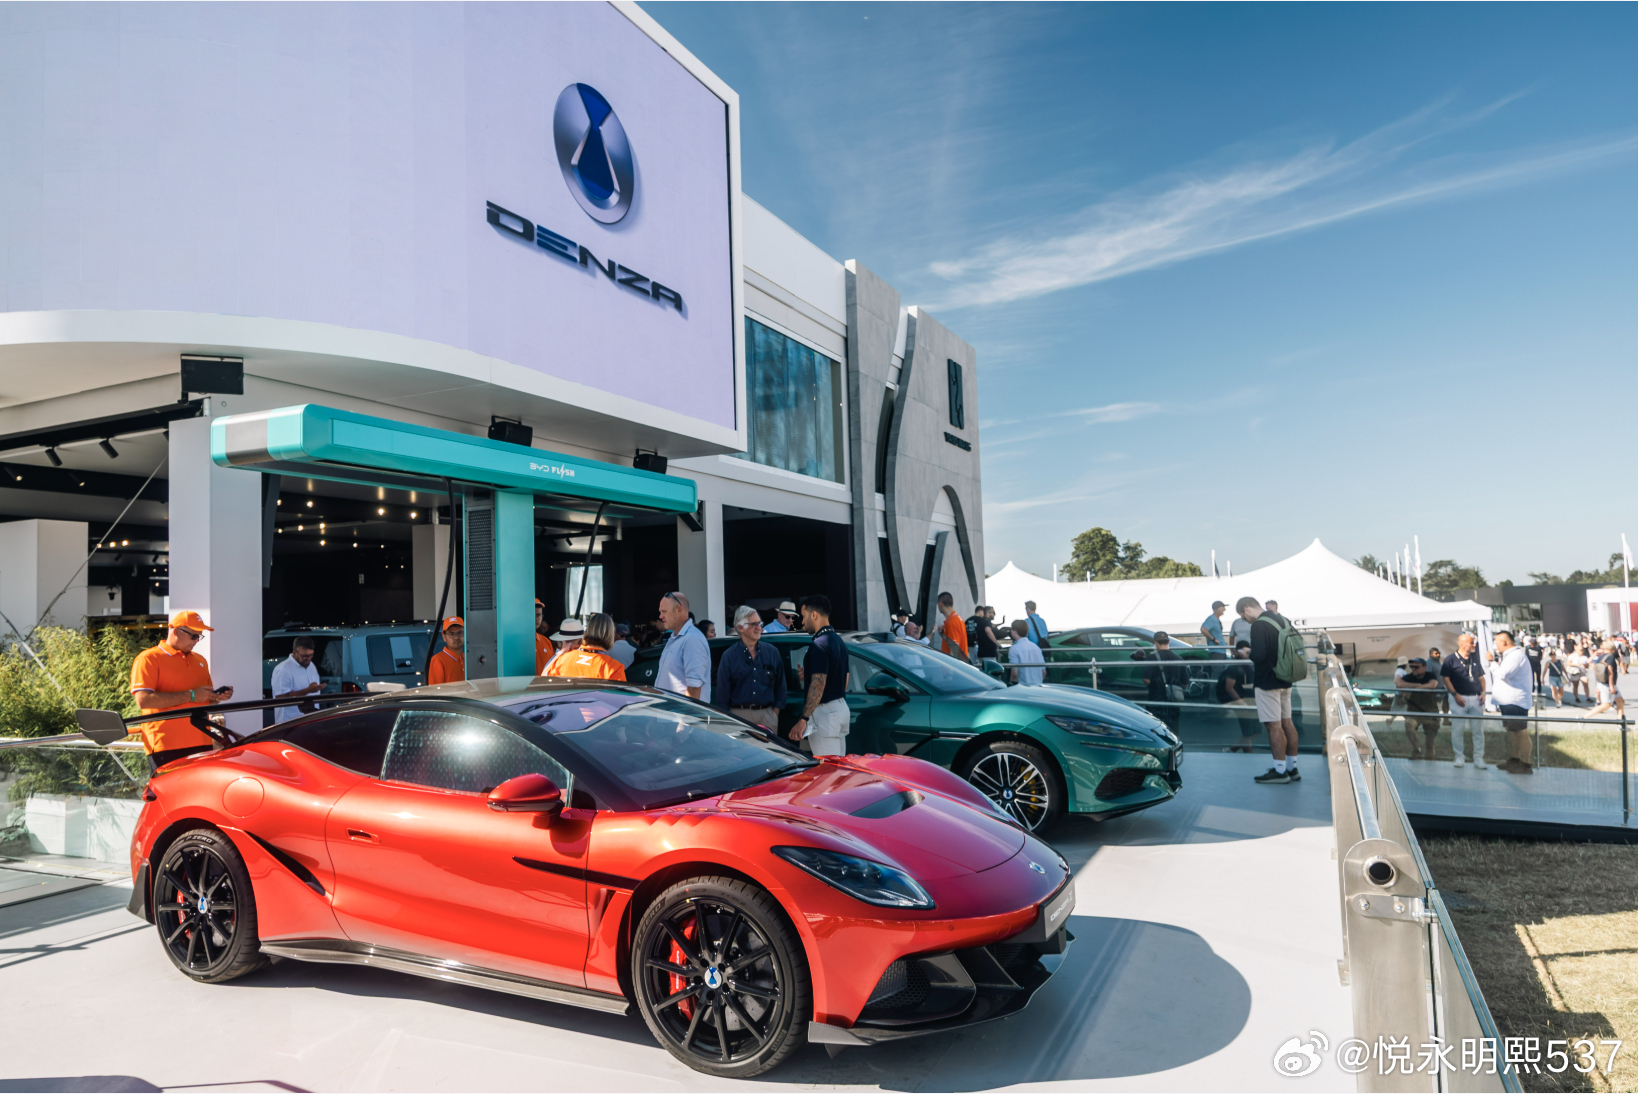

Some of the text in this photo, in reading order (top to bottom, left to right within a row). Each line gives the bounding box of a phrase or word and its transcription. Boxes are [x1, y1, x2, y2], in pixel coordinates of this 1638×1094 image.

[486, 200, 683, 312] DENZA
[529, 462, 550, 472] BYD
[576, 654, 593, 666] Z
